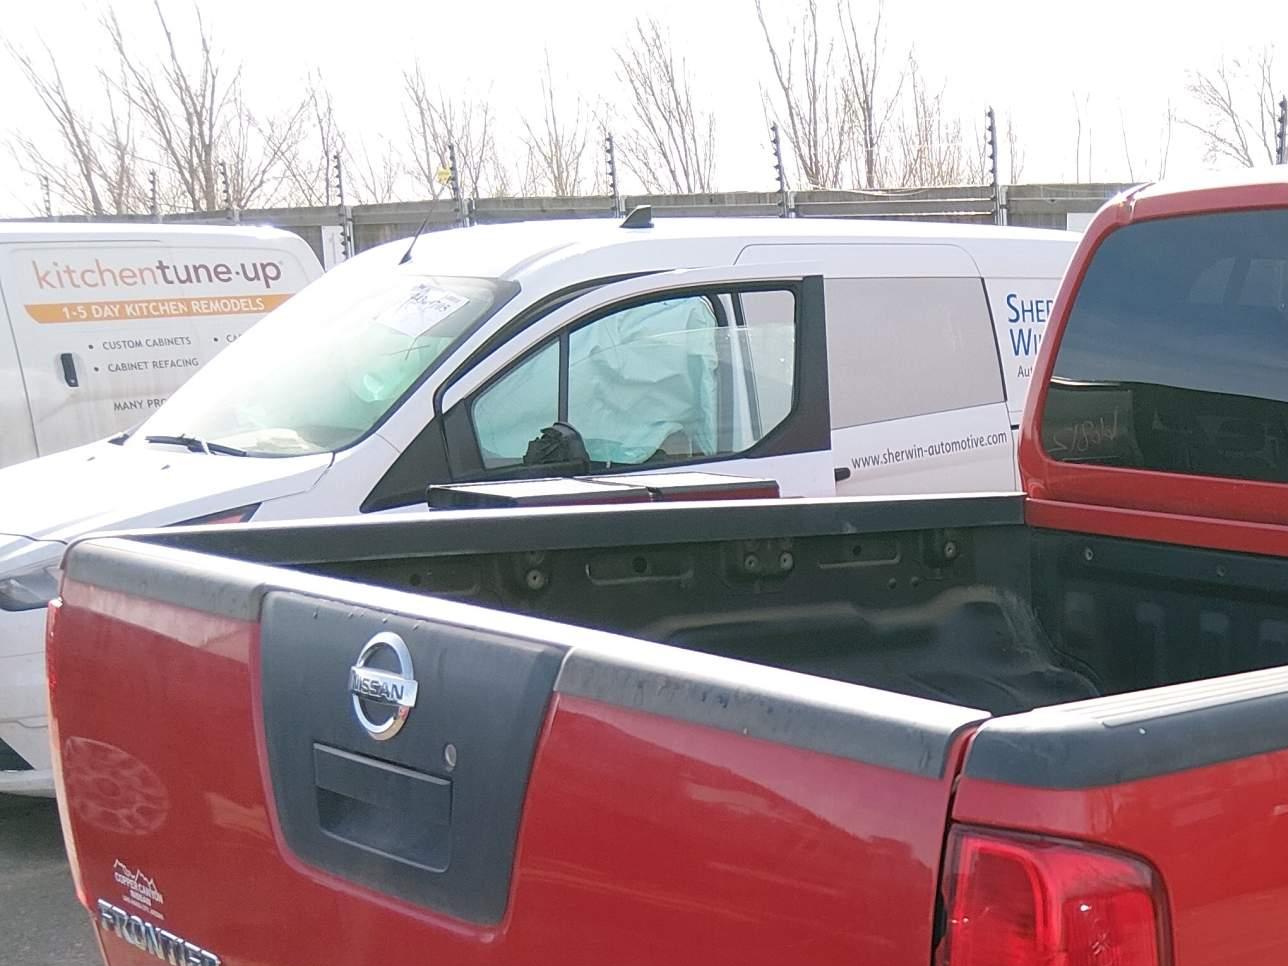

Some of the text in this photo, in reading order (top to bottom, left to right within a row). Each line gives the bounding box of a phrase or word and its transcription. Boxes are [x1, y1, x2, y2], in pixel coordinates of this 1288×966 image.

[62, 297, 265, 319] 1-5 DAY KITCHEN REMODELS
[102, 336, 192, 350] CUSTOM CABINETS
[107, 357, 199, 373] CABINET REFACING
[113, 400, 143, 411] MANY
[851, 430, 1008, 469] www.sherwin-automotive.com
[351, 671, 404, 701] NISSAN
